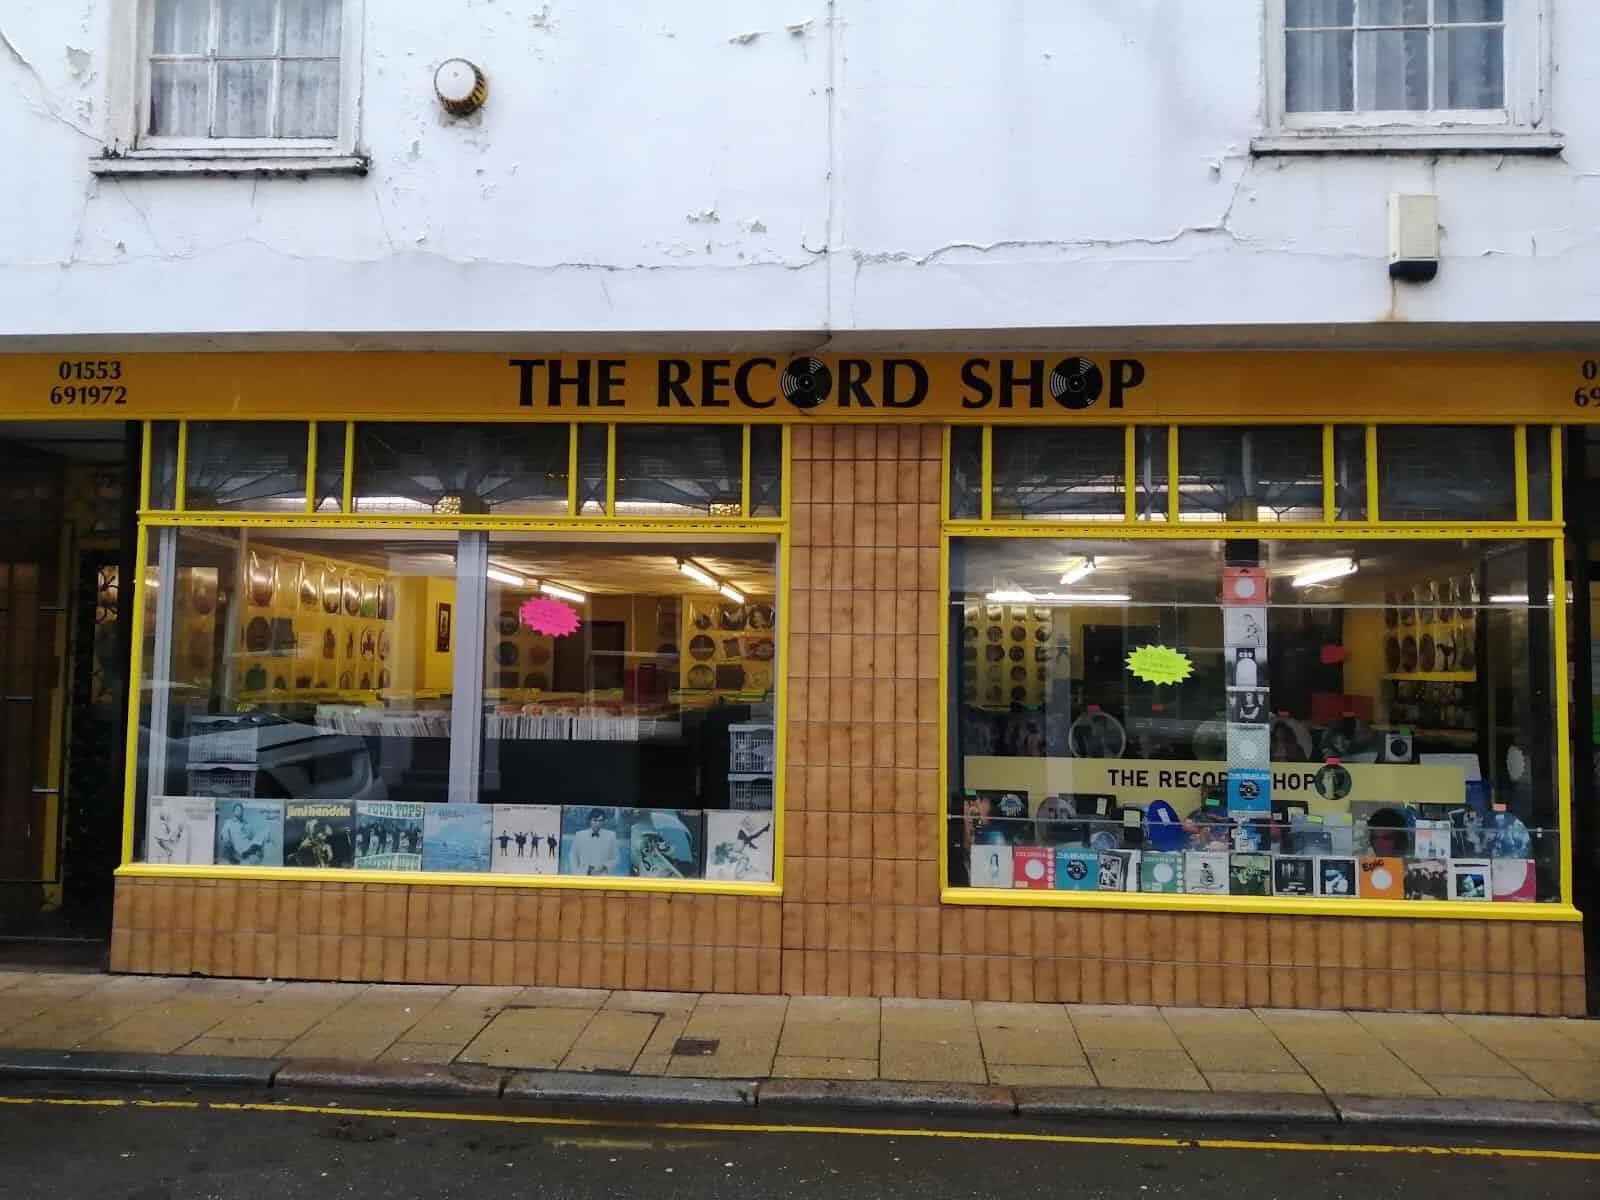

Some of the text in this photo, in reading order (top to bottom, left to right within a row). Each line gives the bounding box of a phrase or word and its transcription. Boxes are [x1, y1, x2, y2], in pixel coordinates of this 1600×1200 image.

[59, 361, 122, 379] 01553
[509, 357, 1145, 410] THE RECORD SHOP
[50, 385, 127, 404] 691972
[1107, 769, 1148, 787] THE
[1273, 773, 1316, 790] HOP
